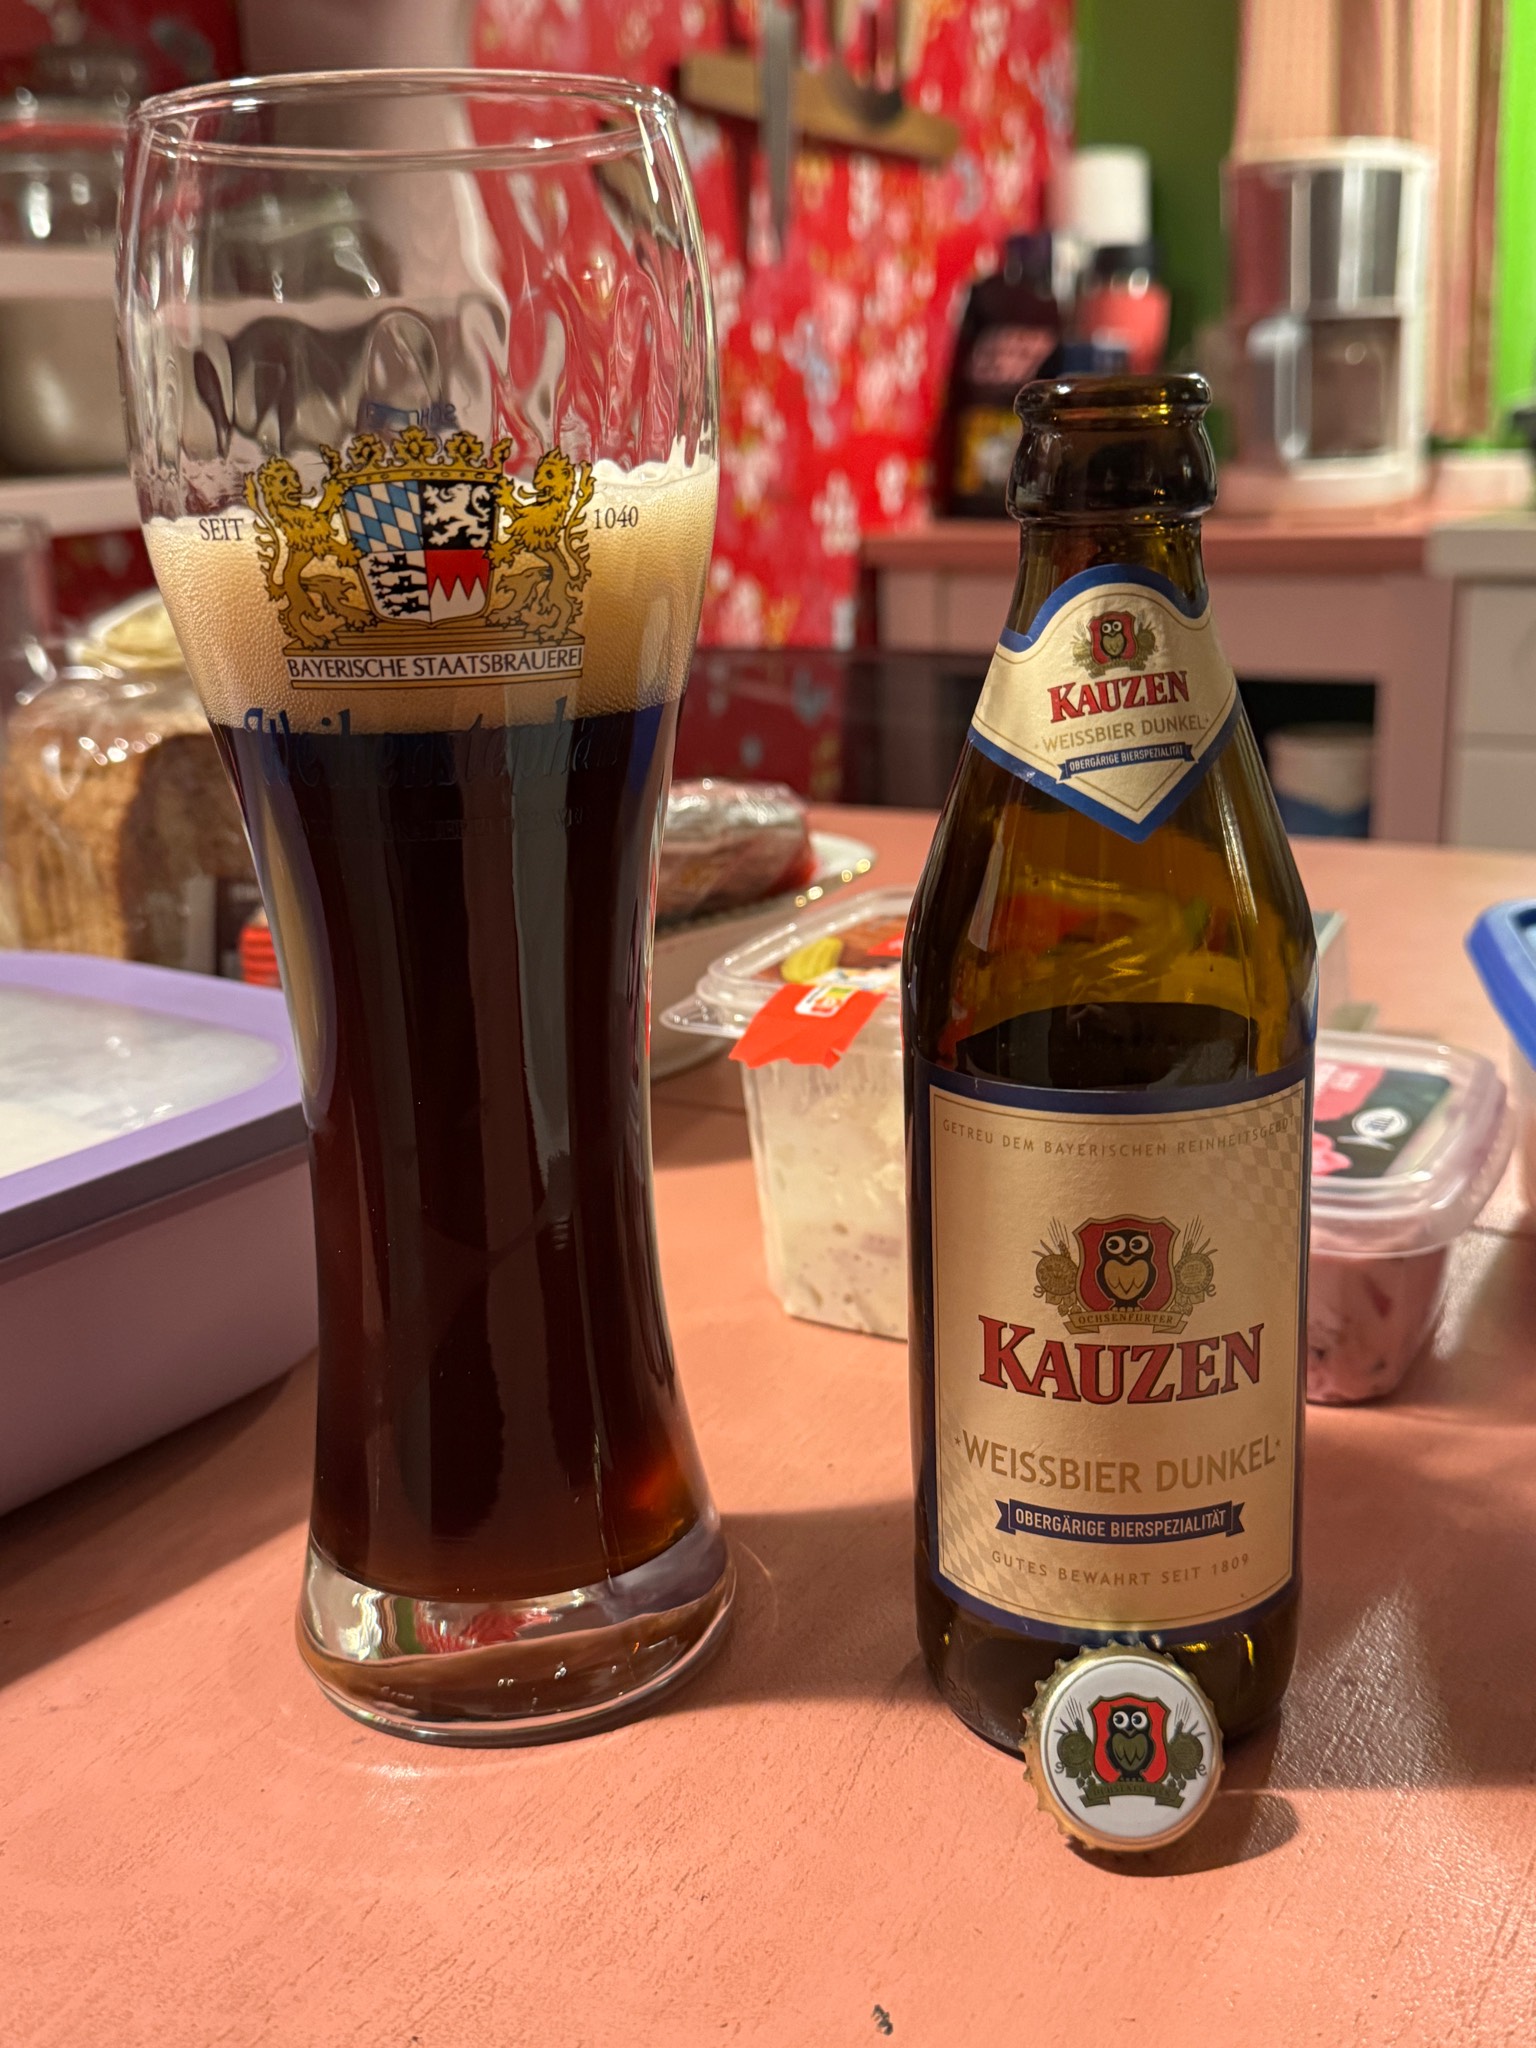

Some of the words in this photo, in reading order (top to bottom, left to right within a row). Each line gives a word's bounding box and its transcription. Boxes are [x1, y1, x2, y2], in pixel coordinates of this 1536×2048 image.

[199, 518, 244, 541] SEIT
[594, 505, 639, 530] 1040
[287, 658, 409, 678] BAYERISCHE
[413, 648, 582, 676] STAATSBRAUEREI
[1047, 671, 1190, 724] KAUZEN
[1042, 721, 1136, 753] WEISSBIER
[1142, 714, 1207, 737] DUNKEL
[1069, 753, 1120, 772] OBERGÄRIGE
[1121, 744, 1184, 762] BIERSPEZIALITÄT
[942, 1118, 994, 1144] GETREU
[1002, 1134, 1034, 1152] DEM
[1045, 1141, 1167, 1157] BAYERISCHEN
[1177, 1115, 1295, 1154] REINHEITSGEBOT
[1078, 1312, 1174, 1325] OCHSENFURTER
[978, 1314, 1265, 1405] KAUZEN
[962, 1429, 1143, 1494] WEISSBIER
[1156, 1434, 1277, 1493] DUNKEL
[1015, 1507, 1106, 1537] OBERGÄRIGE
[1110, 1508, 1228, 1538] BIERSPEZIALITÄT
[991, 1550, 1047, 1577] GUTES
[1058, 1567, 1151, 1586] BEWAHRT
[1162, 1566, 1202, 1584] SEIT
[1211, 1553, 1250, 1577] 1809
